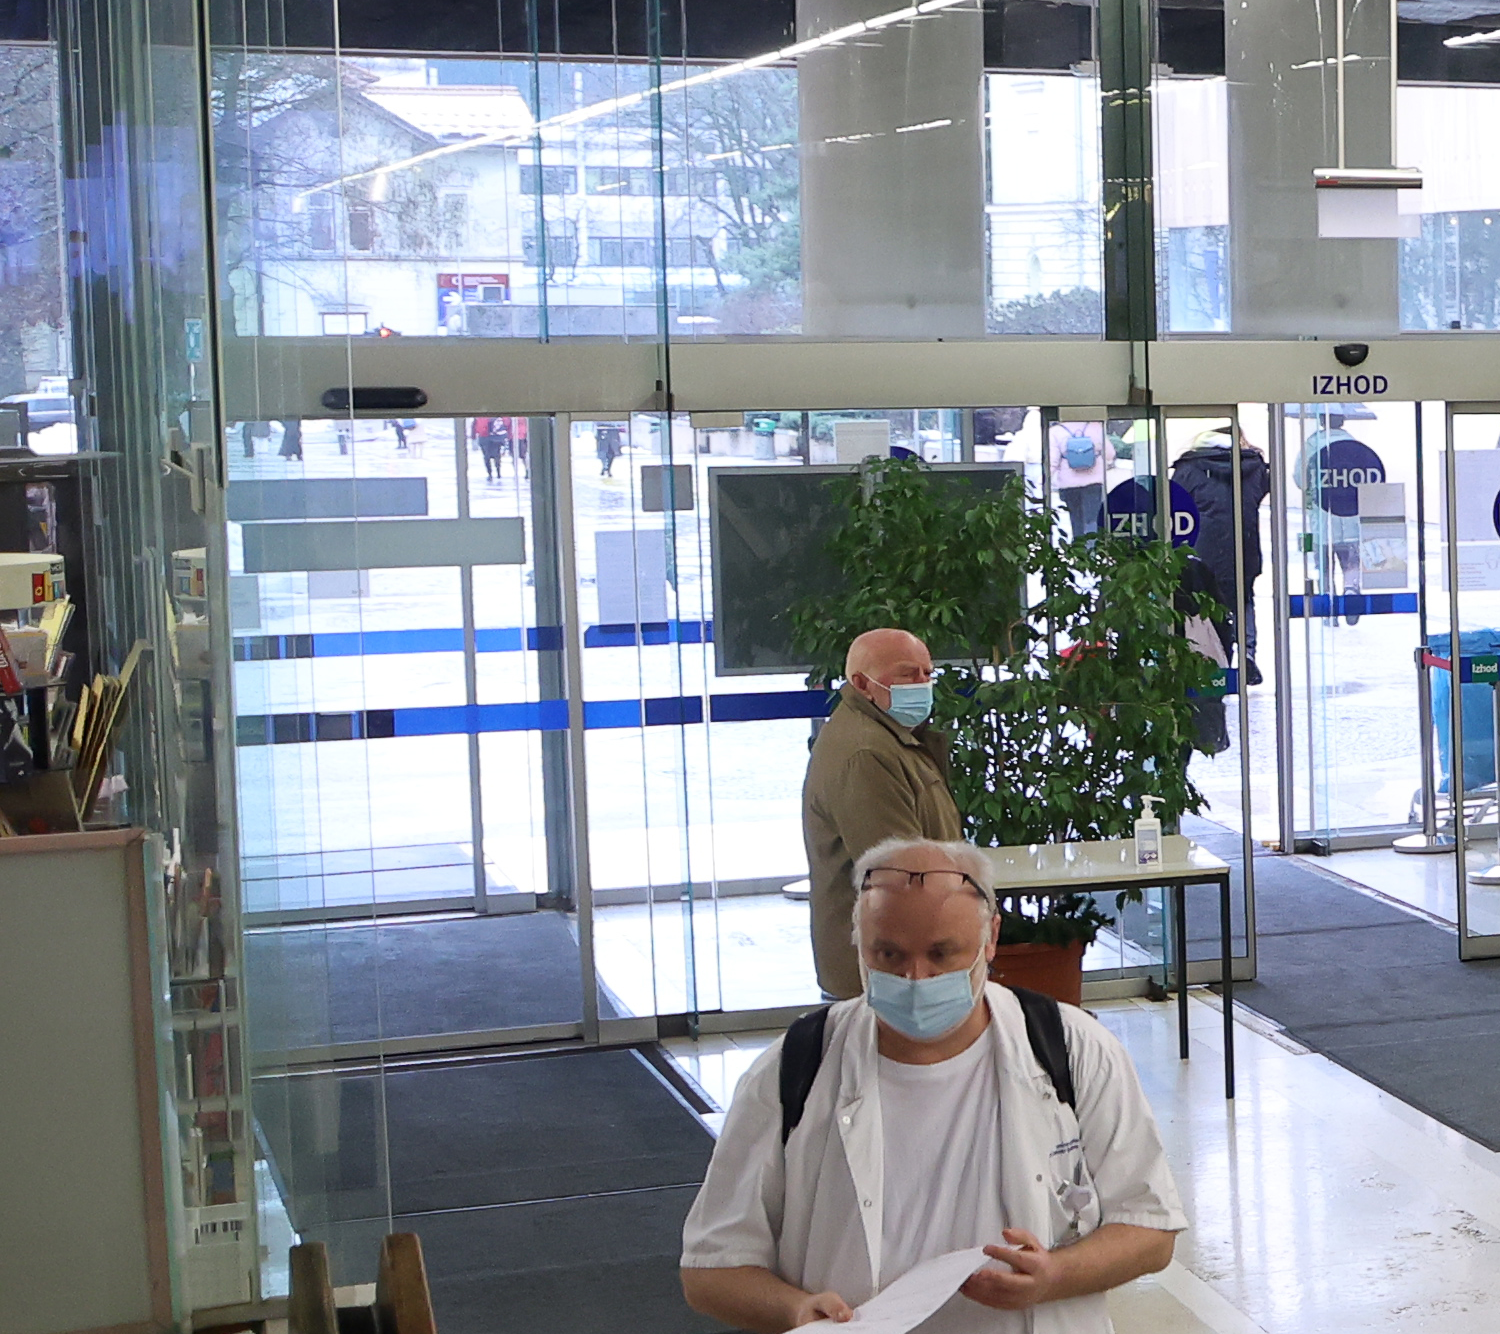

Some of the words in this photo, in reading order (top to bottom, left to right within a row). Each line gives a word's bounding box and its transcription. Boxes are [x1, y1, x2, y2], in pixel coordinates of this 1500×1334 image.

[1313, 375, 1388, 395] IZHOD
[1310, 467, 1382, 488] IZHOD
[1472, 662, 1498, 674] Izhod
